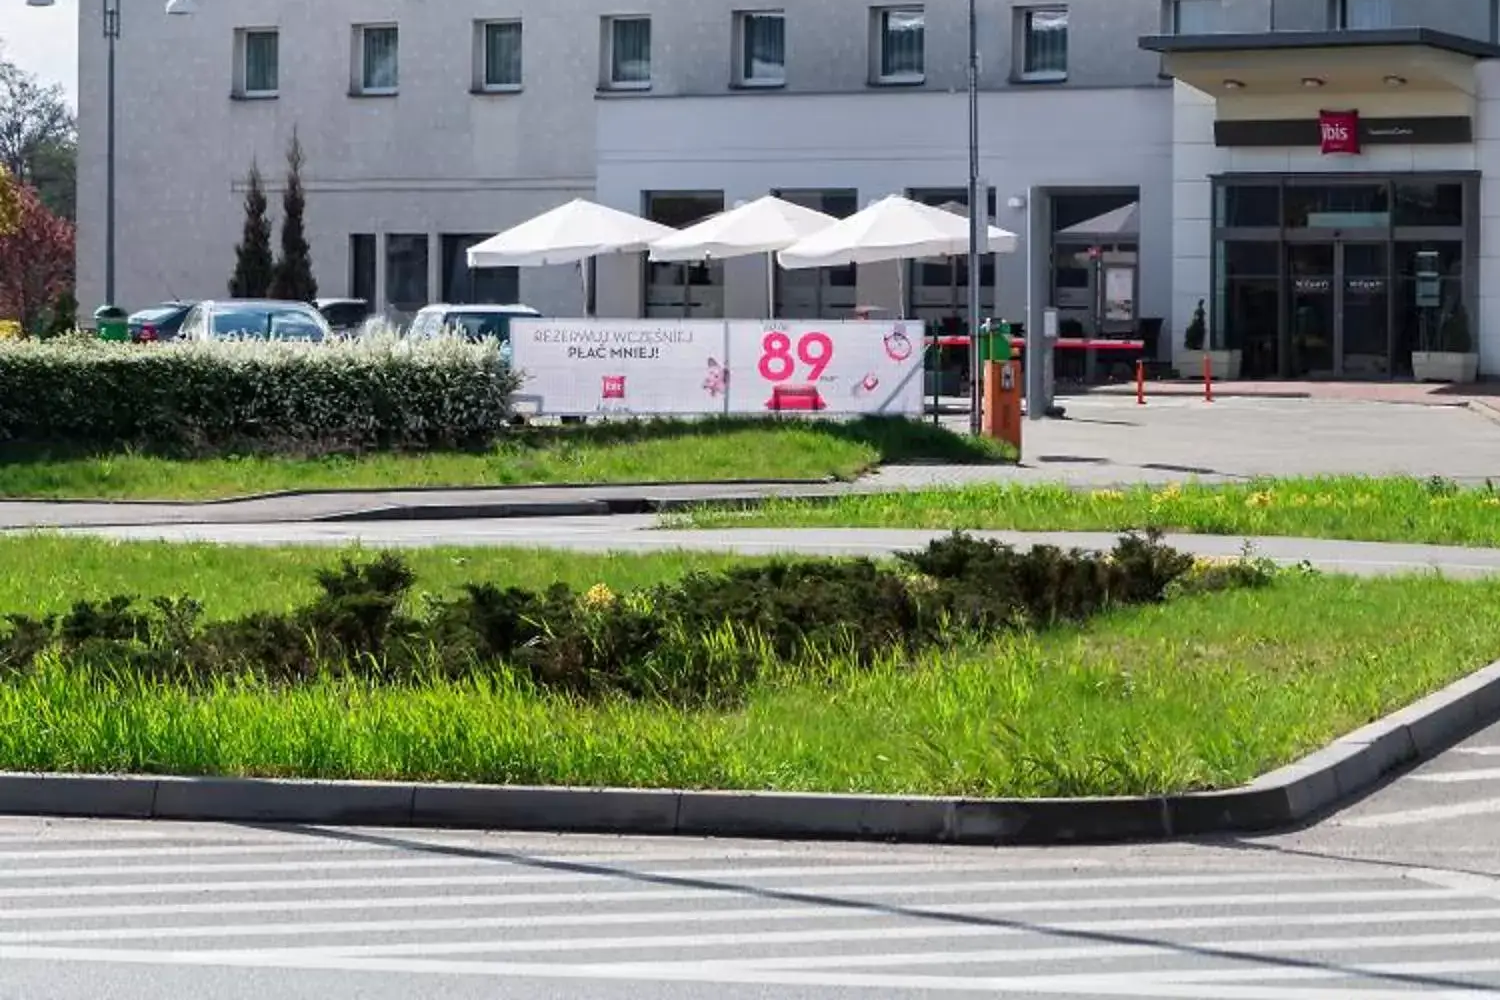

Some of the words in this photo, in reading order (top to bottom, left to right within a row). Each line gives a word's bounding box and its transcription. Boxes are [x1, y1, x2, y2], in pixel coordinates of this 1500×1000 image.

[1321, 123, 1349, 140] ibis
[533, 328, 610, 343] REZERWUJ
[613, 327, 694, 344] WCZEŚNIEJ
[567, 344, 607, 359] PŁAĆ
[609, 346, 660, 359] MNIEJ!
[757, 331, 834, 382] 89
